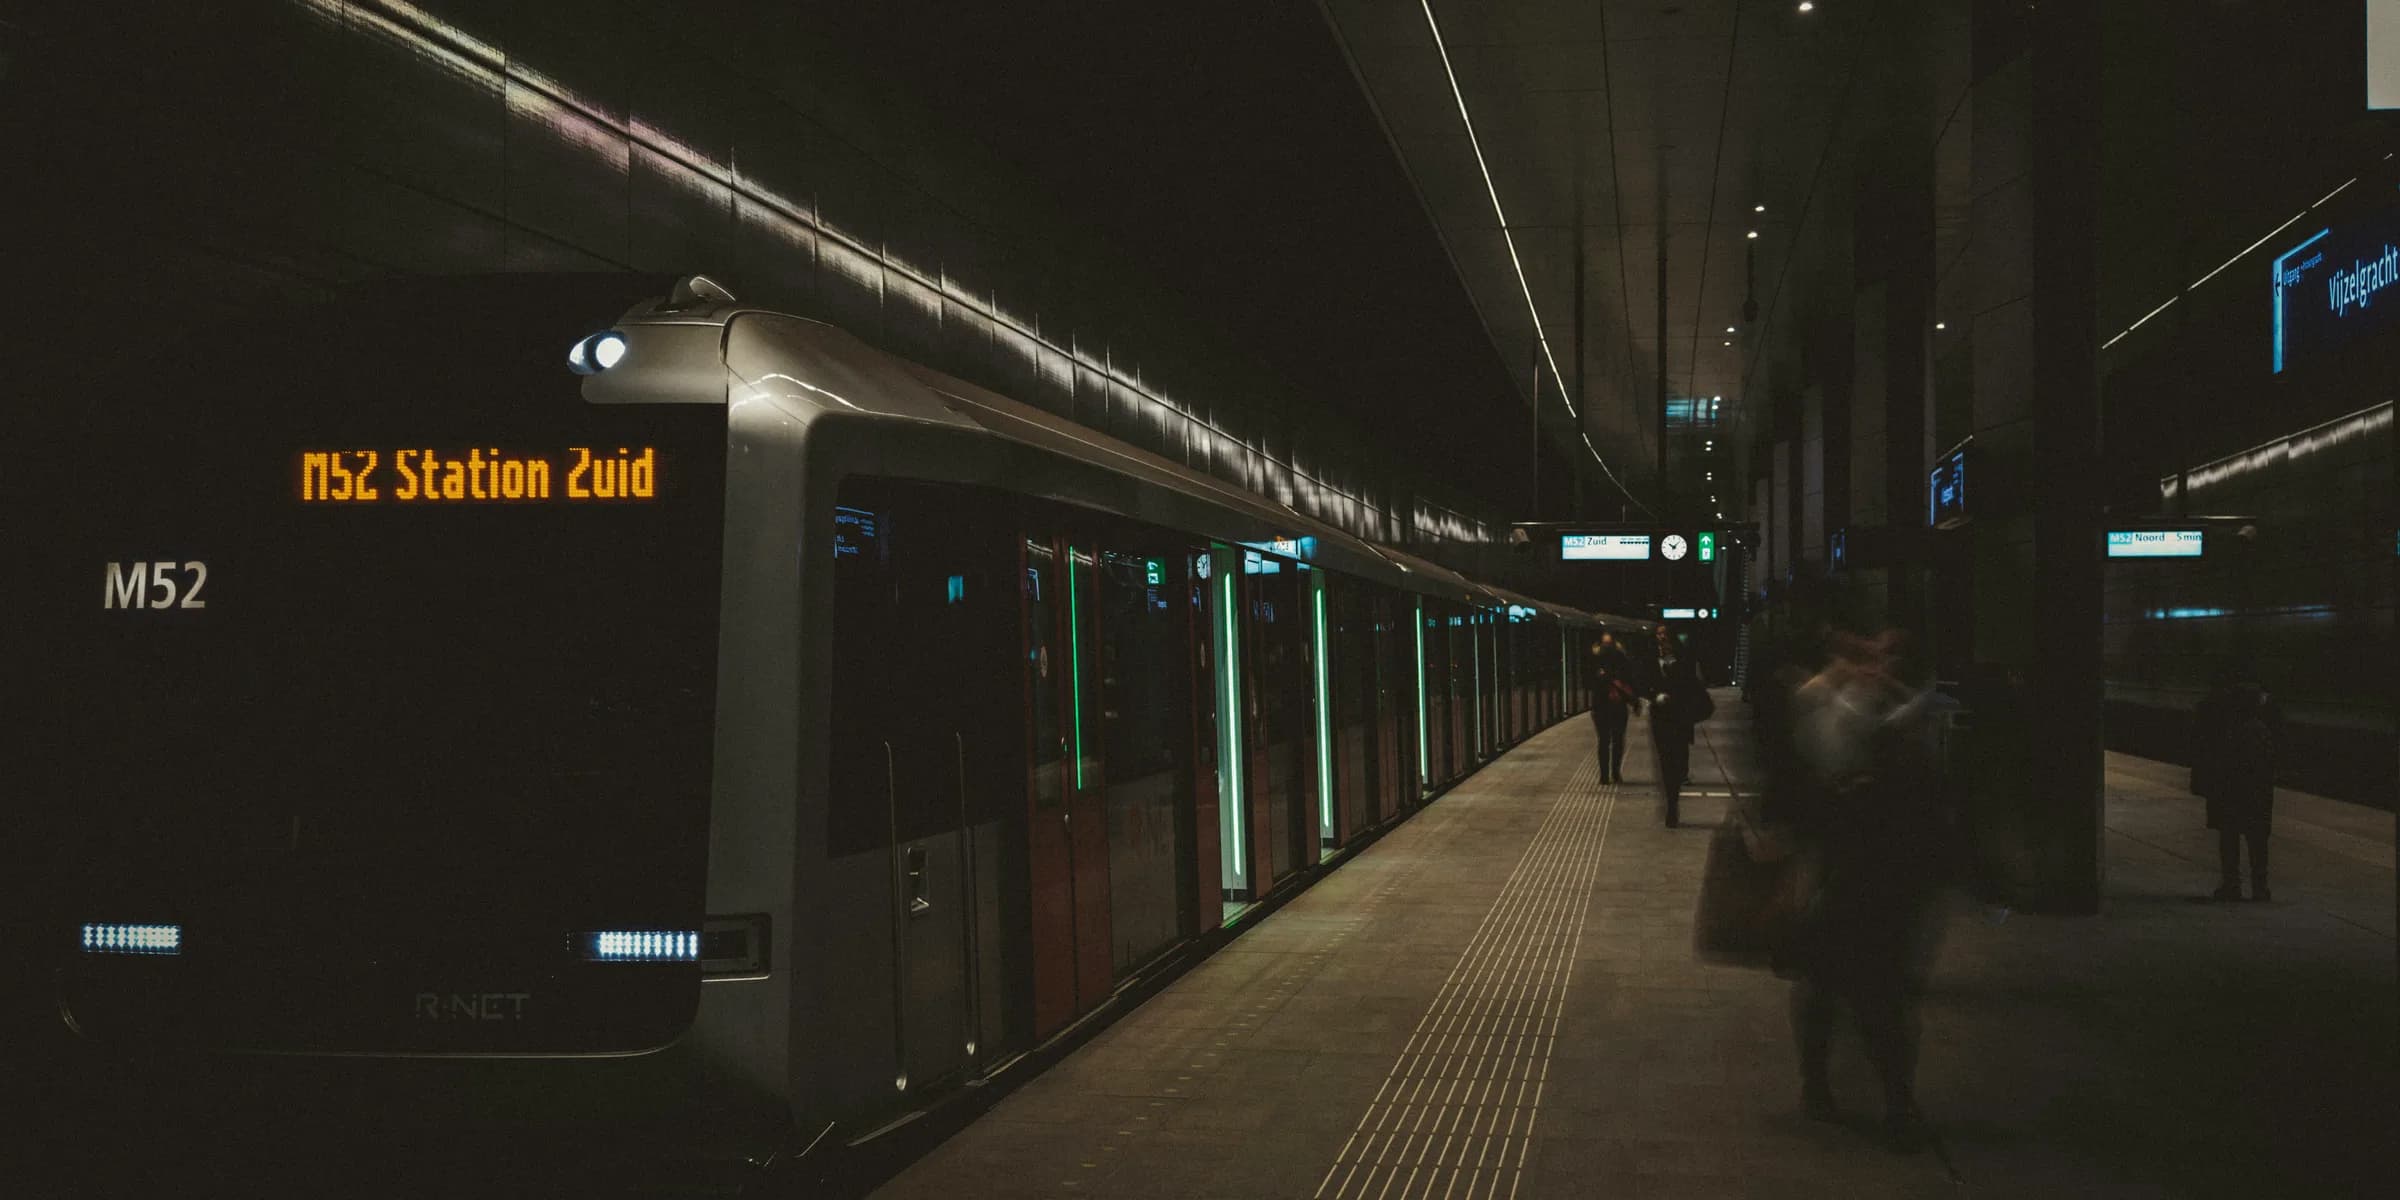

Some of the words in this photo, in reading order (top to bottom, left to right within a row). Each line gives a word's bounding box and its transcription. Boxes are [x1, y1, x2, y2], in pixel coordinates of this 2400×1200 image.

[2328, 243, 2399, 318] Vijzelgracht
[302, 449, 379, 501] M52
[396, 448, 550, 500] Station
[567, 447, 656, 499] Zuid
[1587, 537, 1607, 546] Zuid
[2110, 533, 2132, 542] M52
[2135, 533, 2165, 542] Noord
[103, 561, 208, 609] M52
